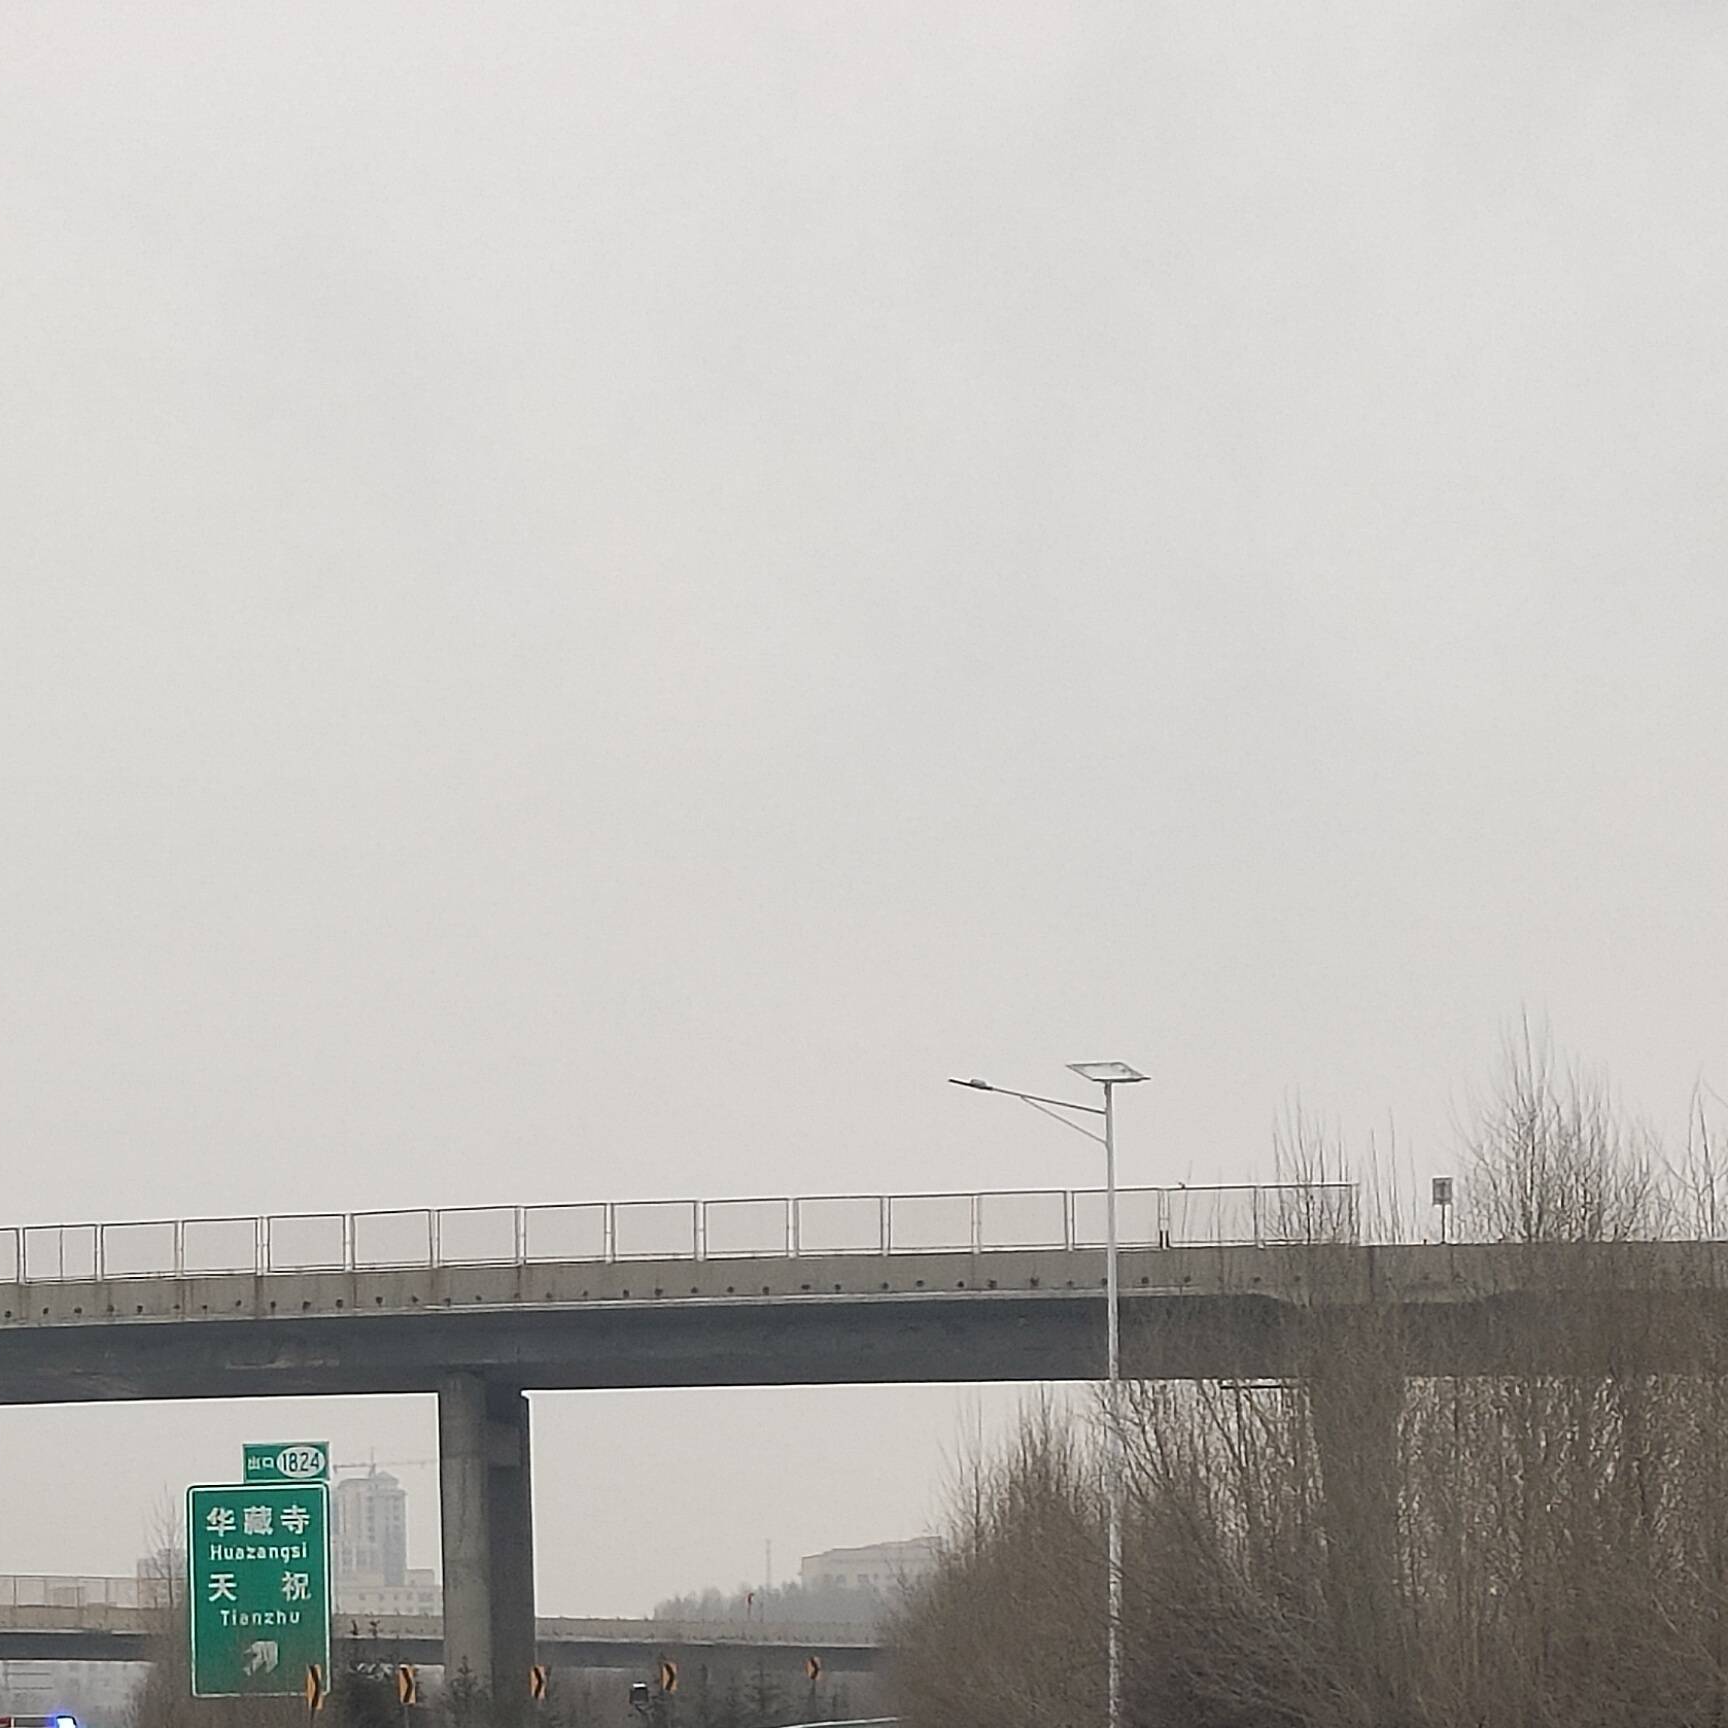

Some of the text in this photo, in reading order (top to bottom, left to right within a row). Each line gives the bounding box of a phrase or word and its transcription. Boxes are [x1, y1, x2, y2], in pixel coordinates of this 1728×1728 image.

[247, 1452, 320, 1472] 出口 1824
[206, 1504, 311, 1537] 华藏寺
[210, 1541, 307, 1563] Huazangsi
[220, 1608, 301, 1627] Tianzhu
